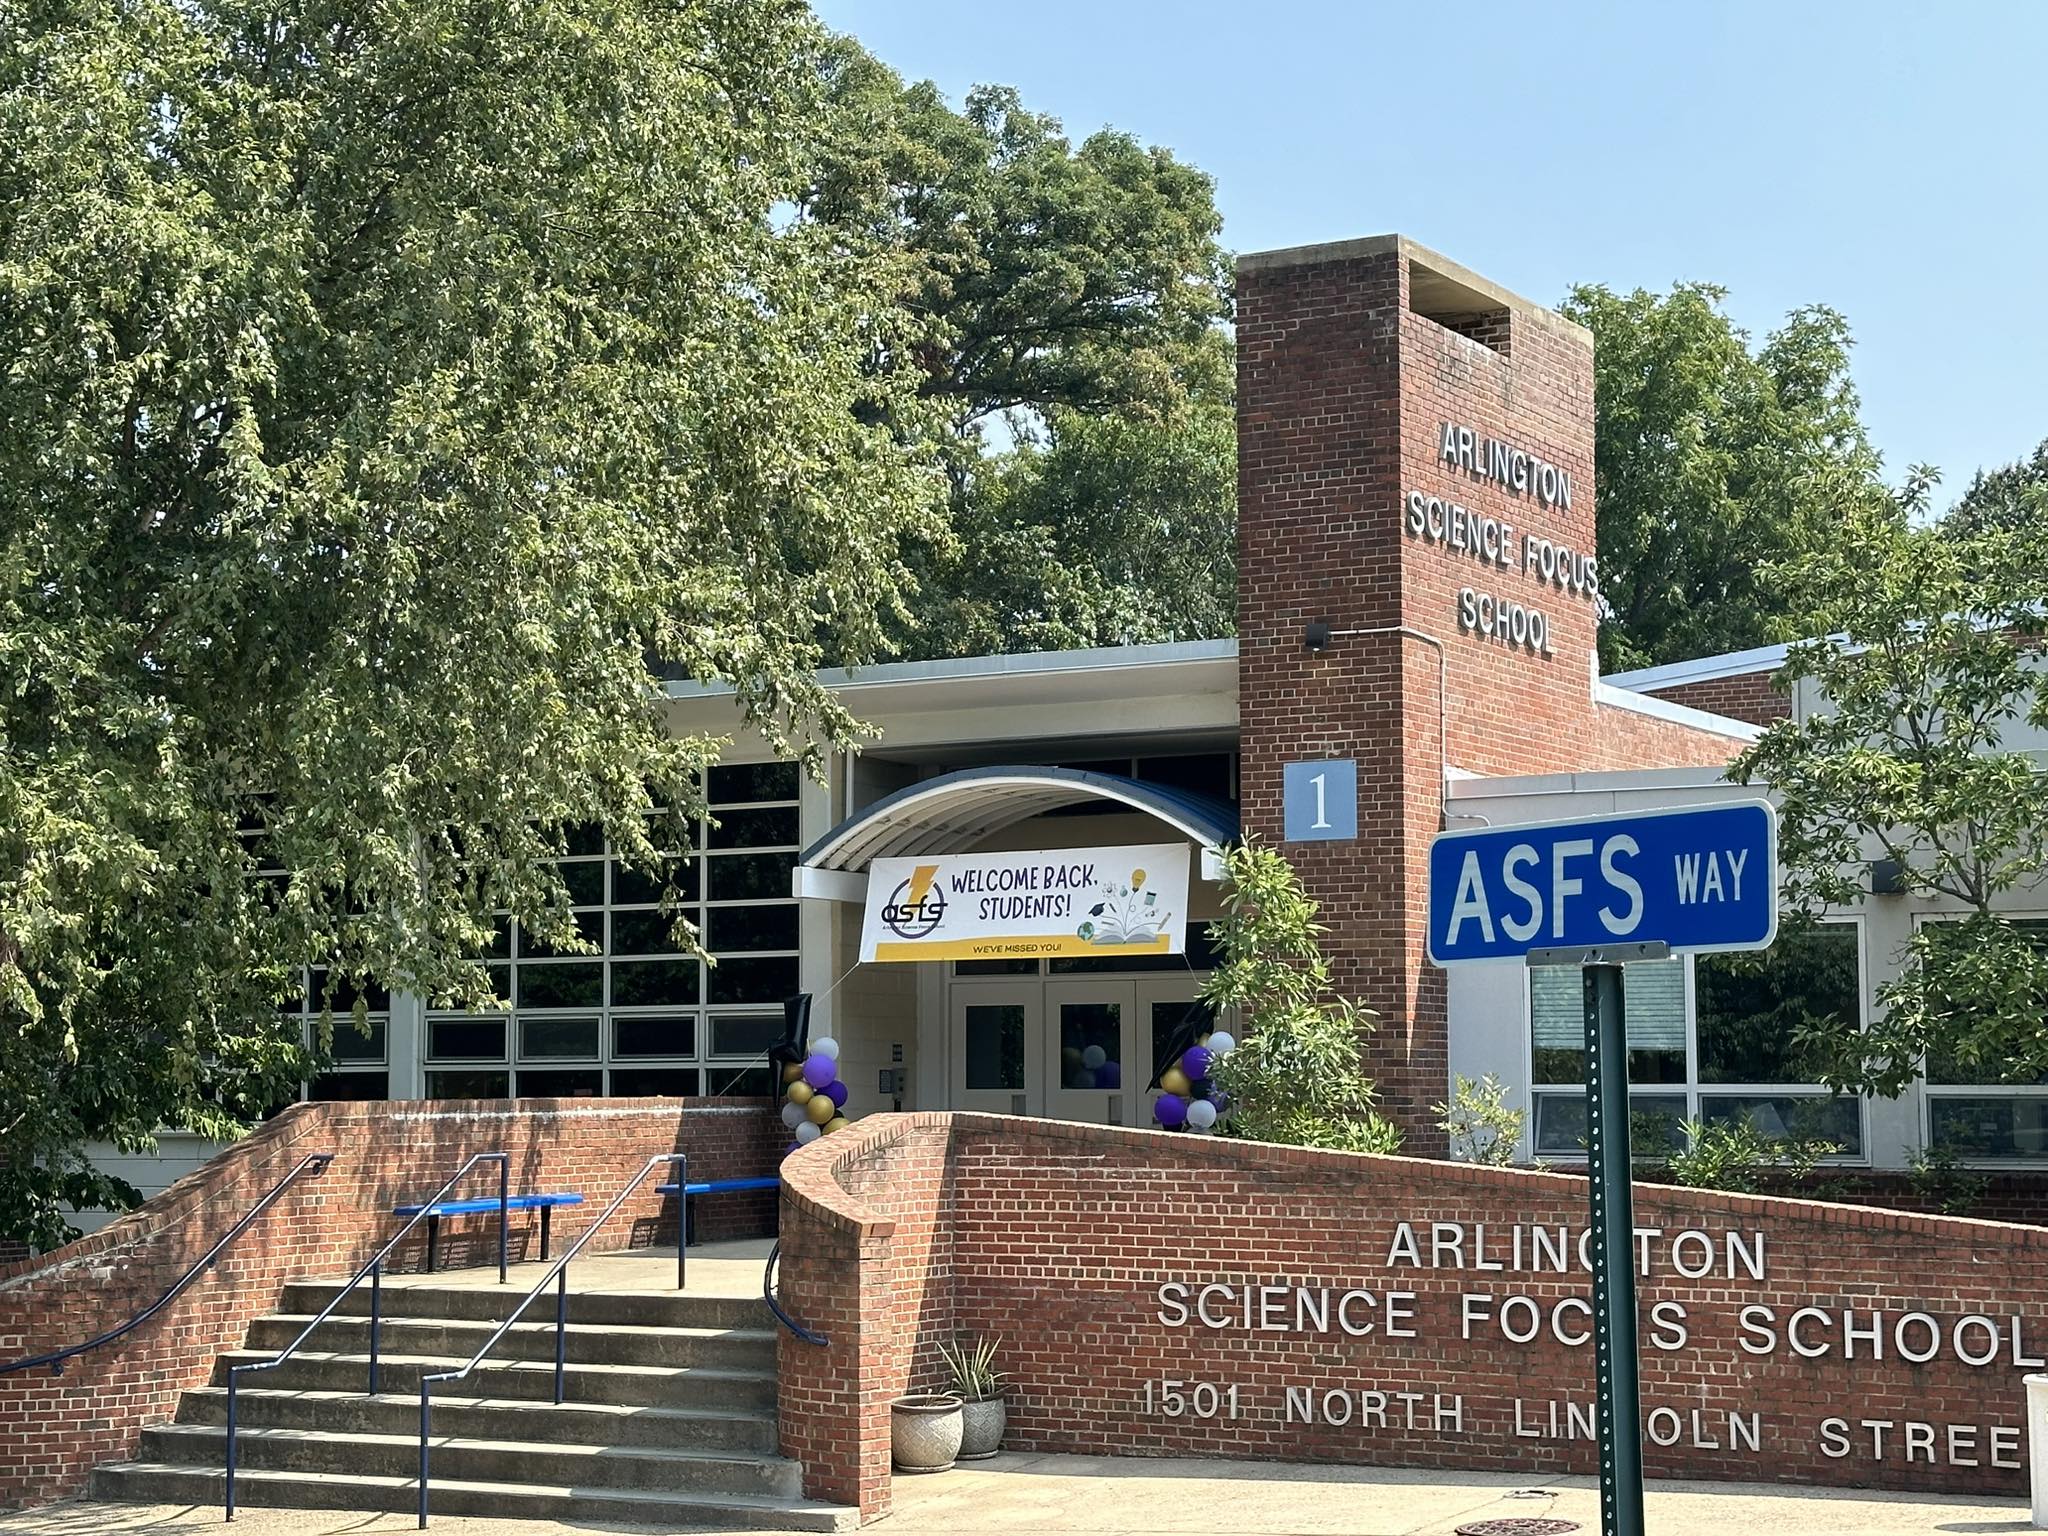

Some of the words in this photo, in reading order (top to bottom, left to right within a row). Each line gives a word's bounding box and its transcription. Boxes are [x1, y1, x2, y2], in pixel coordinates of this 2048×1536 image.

[1441, 421, 1572, 510] ARLINGTON
[1407, 490, 1514, 565] SCIENCE
[1524, 534, 1599, 595] FOCUS
[1460, 587, 1557, 654] SCHOOL
[1309, 773, 1332, 829] 1
[951, 867, 1038, 894] WELCOME
[1043, 864, 1098, 890] BACK,
[978, 894, 1071, 920] STUDENTS!
[1445, 834, 1644, 946] ASFS
[1674, 848, 1749, 905] WAY
[1004, 944, 1038, 953] MISSED
[1040, 943, 1062, 952] YOU!
[1157, 1282, 1417, 1338] SCIENCE
[1462, 1293, 1688, 1351] FOCS
[1738, 1304, 2046, 1367] SCHOOL
[1142, 1379, 1238, 1420] 1501
[1285, 1386, 1463, 1433] NORTH
[1514, 1398, 1760, 1452] LINOLN
[1819, 1417, 2022, 1469] STREE
